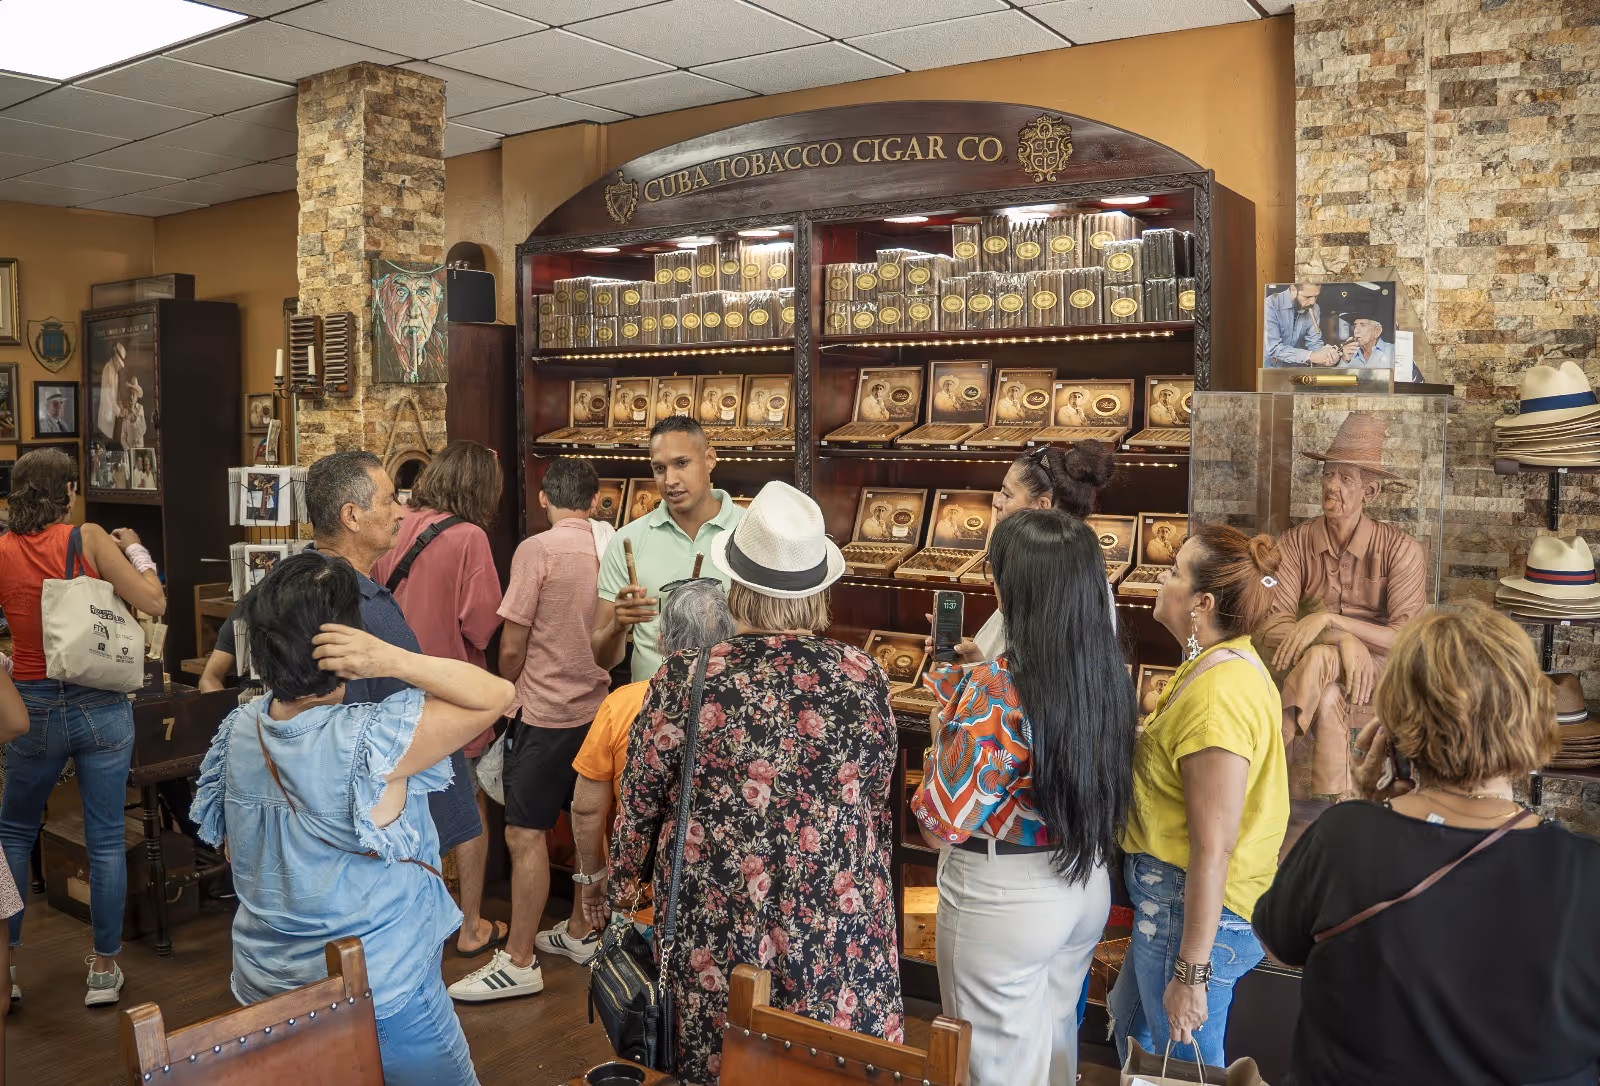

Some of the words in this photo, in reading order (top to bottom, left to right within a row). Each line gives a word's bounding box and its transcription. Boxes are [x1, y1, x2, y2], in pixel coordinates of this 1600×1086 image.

[643, 166, 710, 203] CUBA
[713, 141, 842, 183] TOBACCO
[852, 135, 948, 163] CIGAR
[162, 717, 176, 741] 7
